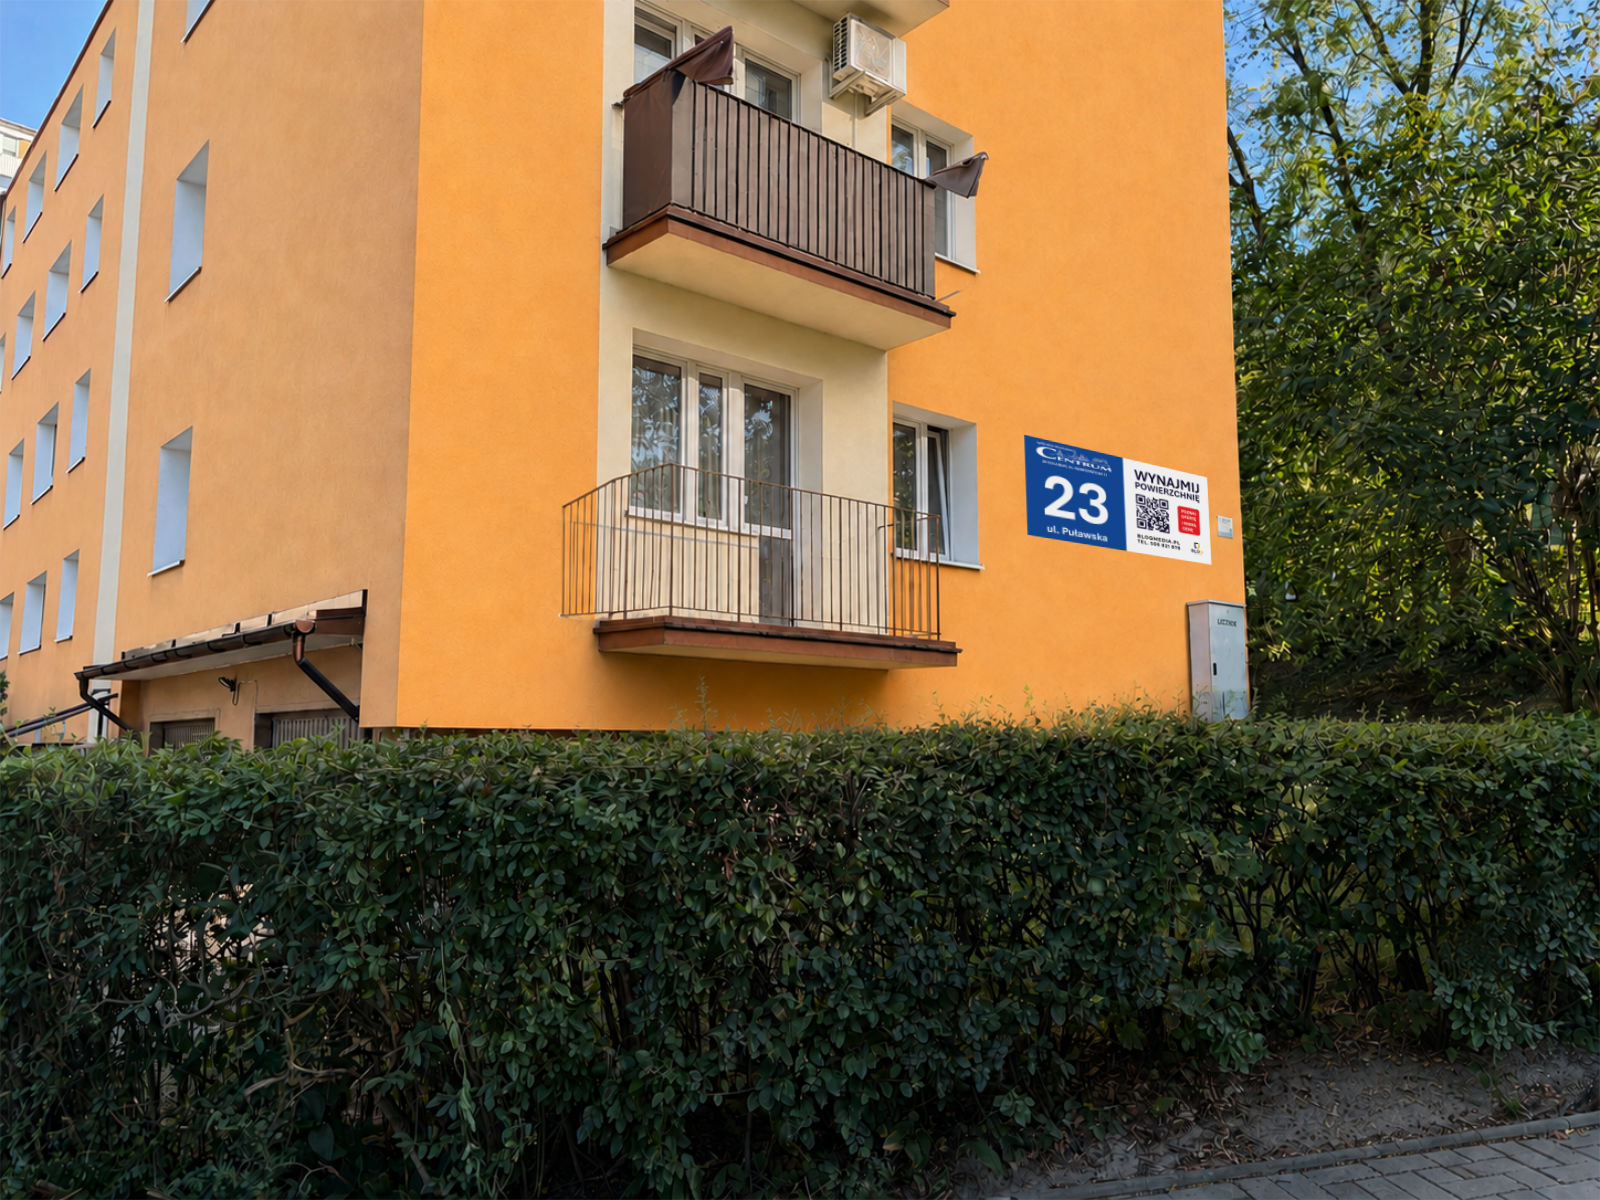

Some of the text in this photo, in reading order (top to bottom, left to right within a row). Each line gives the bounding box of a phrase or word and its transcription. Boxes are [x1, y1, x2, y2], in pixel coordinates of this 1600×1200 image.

[1036, 446, 1112, 472] CENTRUM
[1134, 469, 1200, 494] WYNAJMIJ
[1135, 482, 1200, 503] POWIERZCHNIĘ
[1044, 475, 1109, 525] 23
[1047, 526, 1109, 542] ul. Puławska
